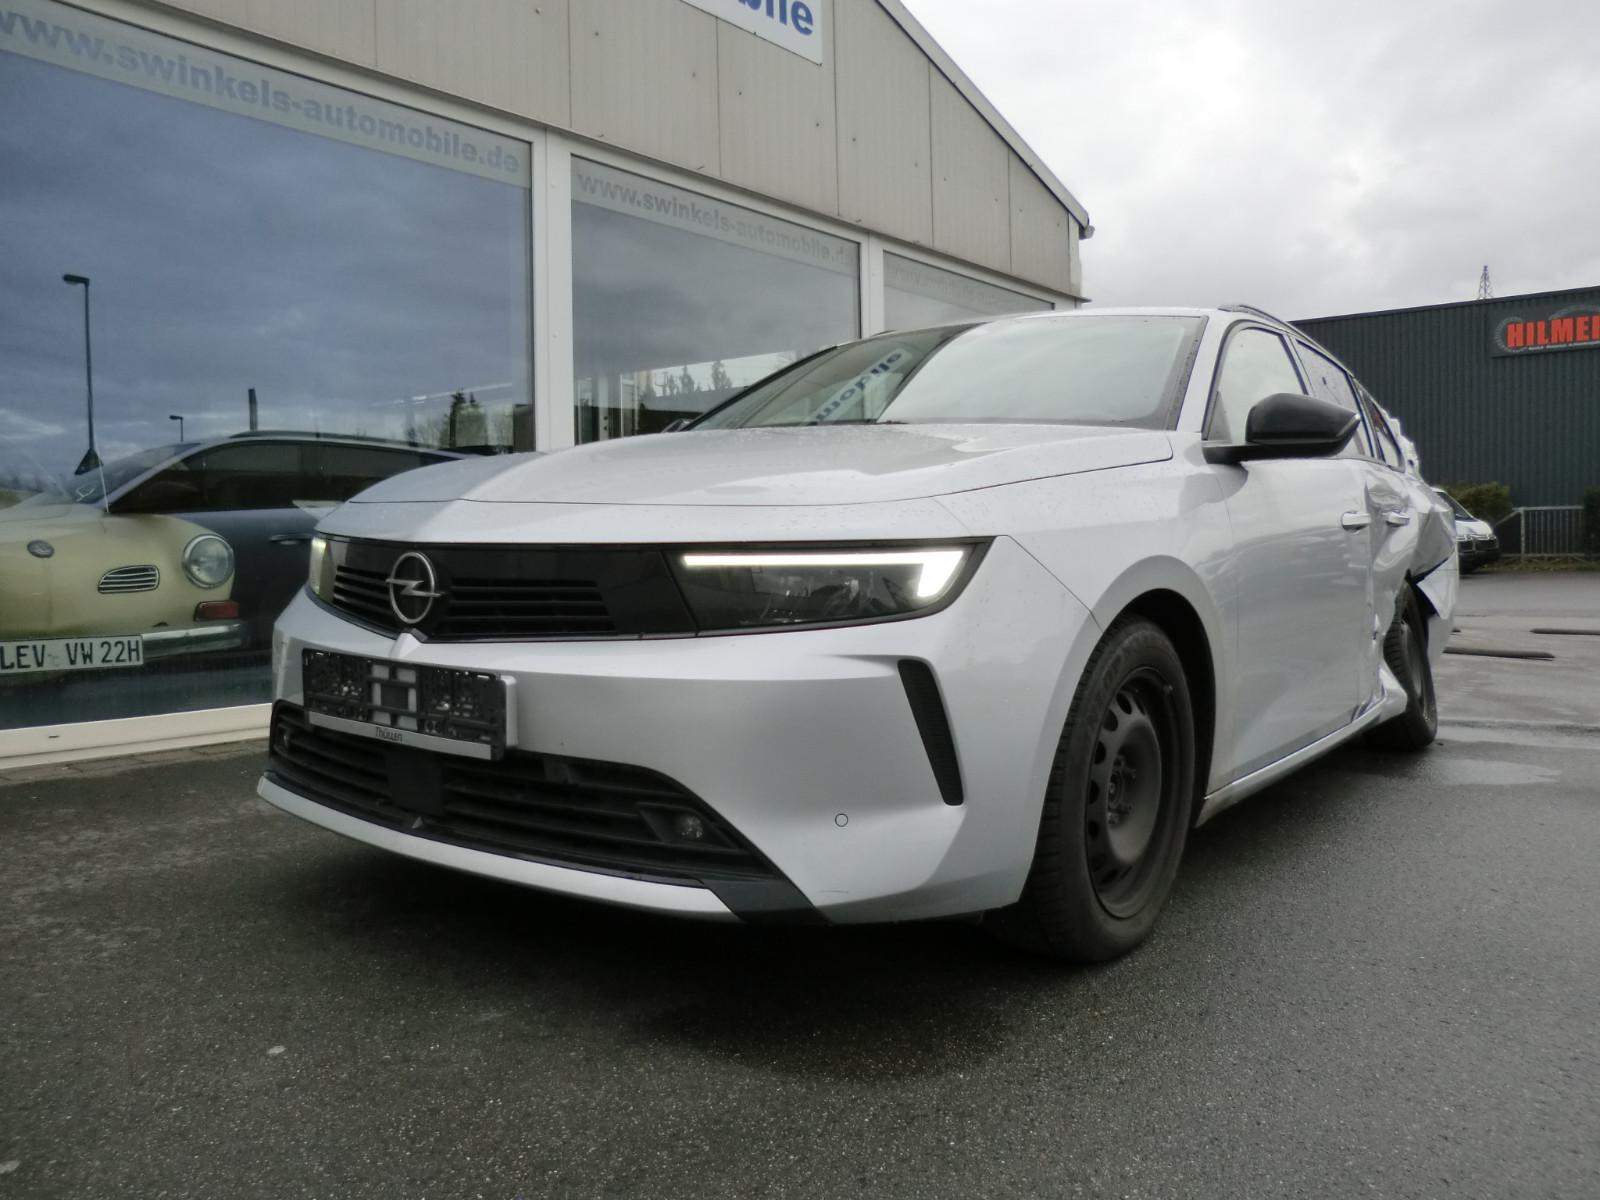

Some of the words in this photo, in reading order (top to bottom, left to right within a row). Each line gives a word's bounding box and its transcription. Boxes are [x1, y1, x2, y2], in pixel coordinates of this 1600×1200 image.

[738, 0, 813, 36] le
[0, 644, 46, 669] LEV
[65, 642, 94, 665] VW
[100, 640, 140, 663] 22H
